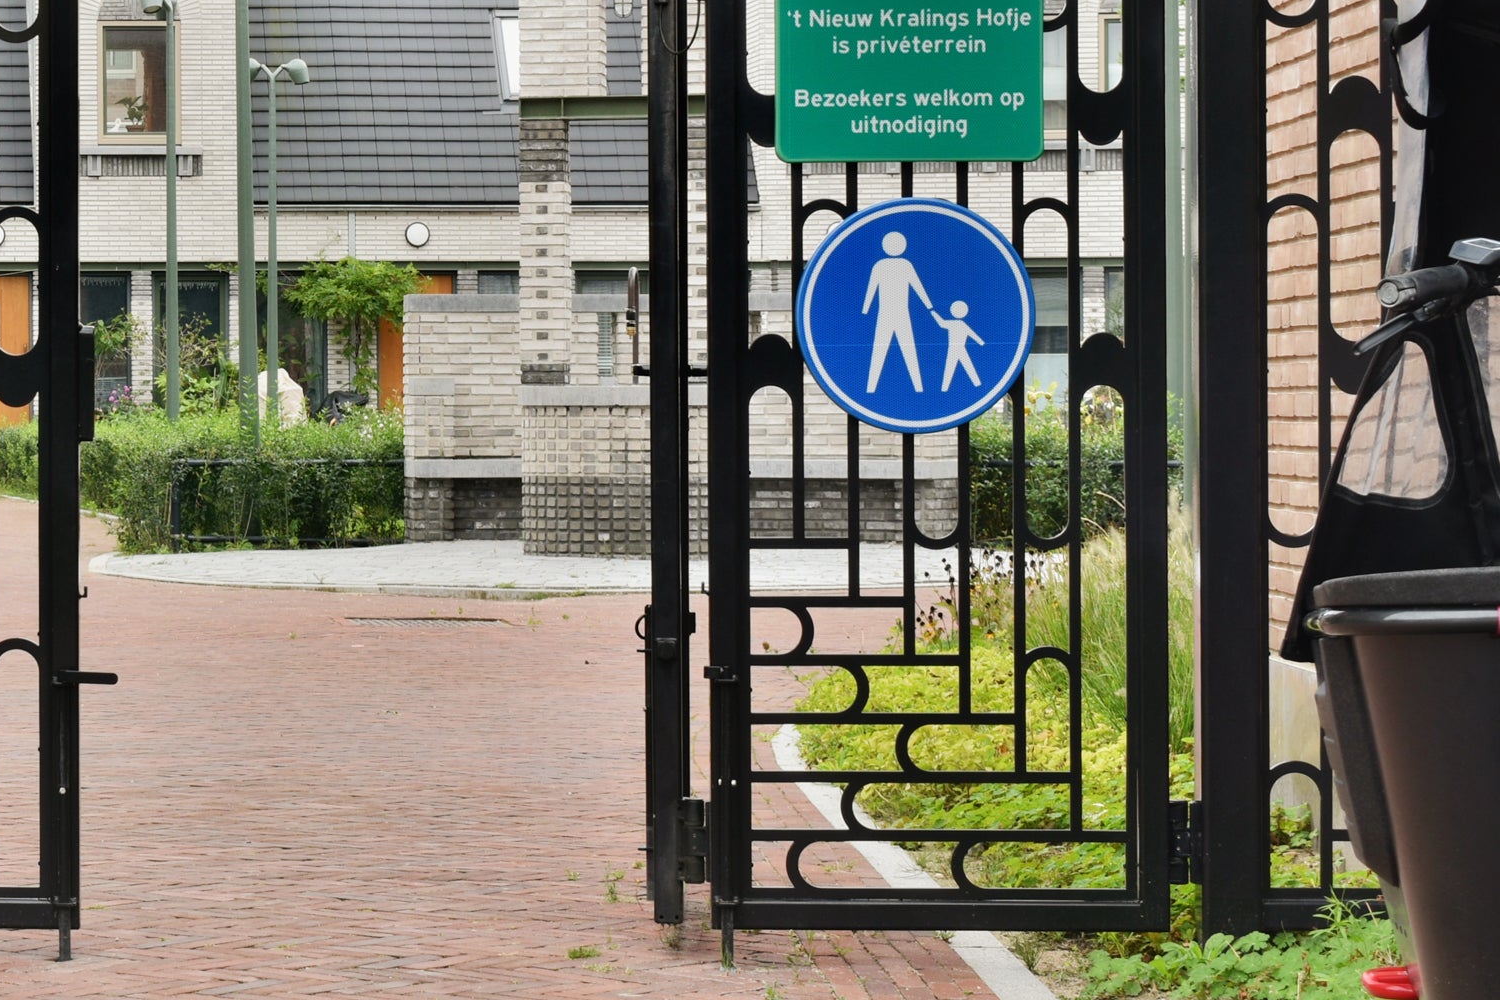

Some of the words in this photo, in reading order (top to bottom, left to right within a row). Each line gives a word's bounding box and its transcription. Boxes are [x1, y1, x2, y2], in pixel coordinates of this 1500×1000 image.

[809, 9, 873, 28] Nieuw
[880, 8, 970, 32] Kralings
[976, 8, 1032, 32] Hofje
[832, 36, 850, 54] is
[856, 35, 987, 59] privéterrein
[794, 89, 907, 108] Bezoekers
[913, 89, 993, 107] welkom
[999, 91, 1025, 111] op
[851, 115, 968, 138] uitnodiging
